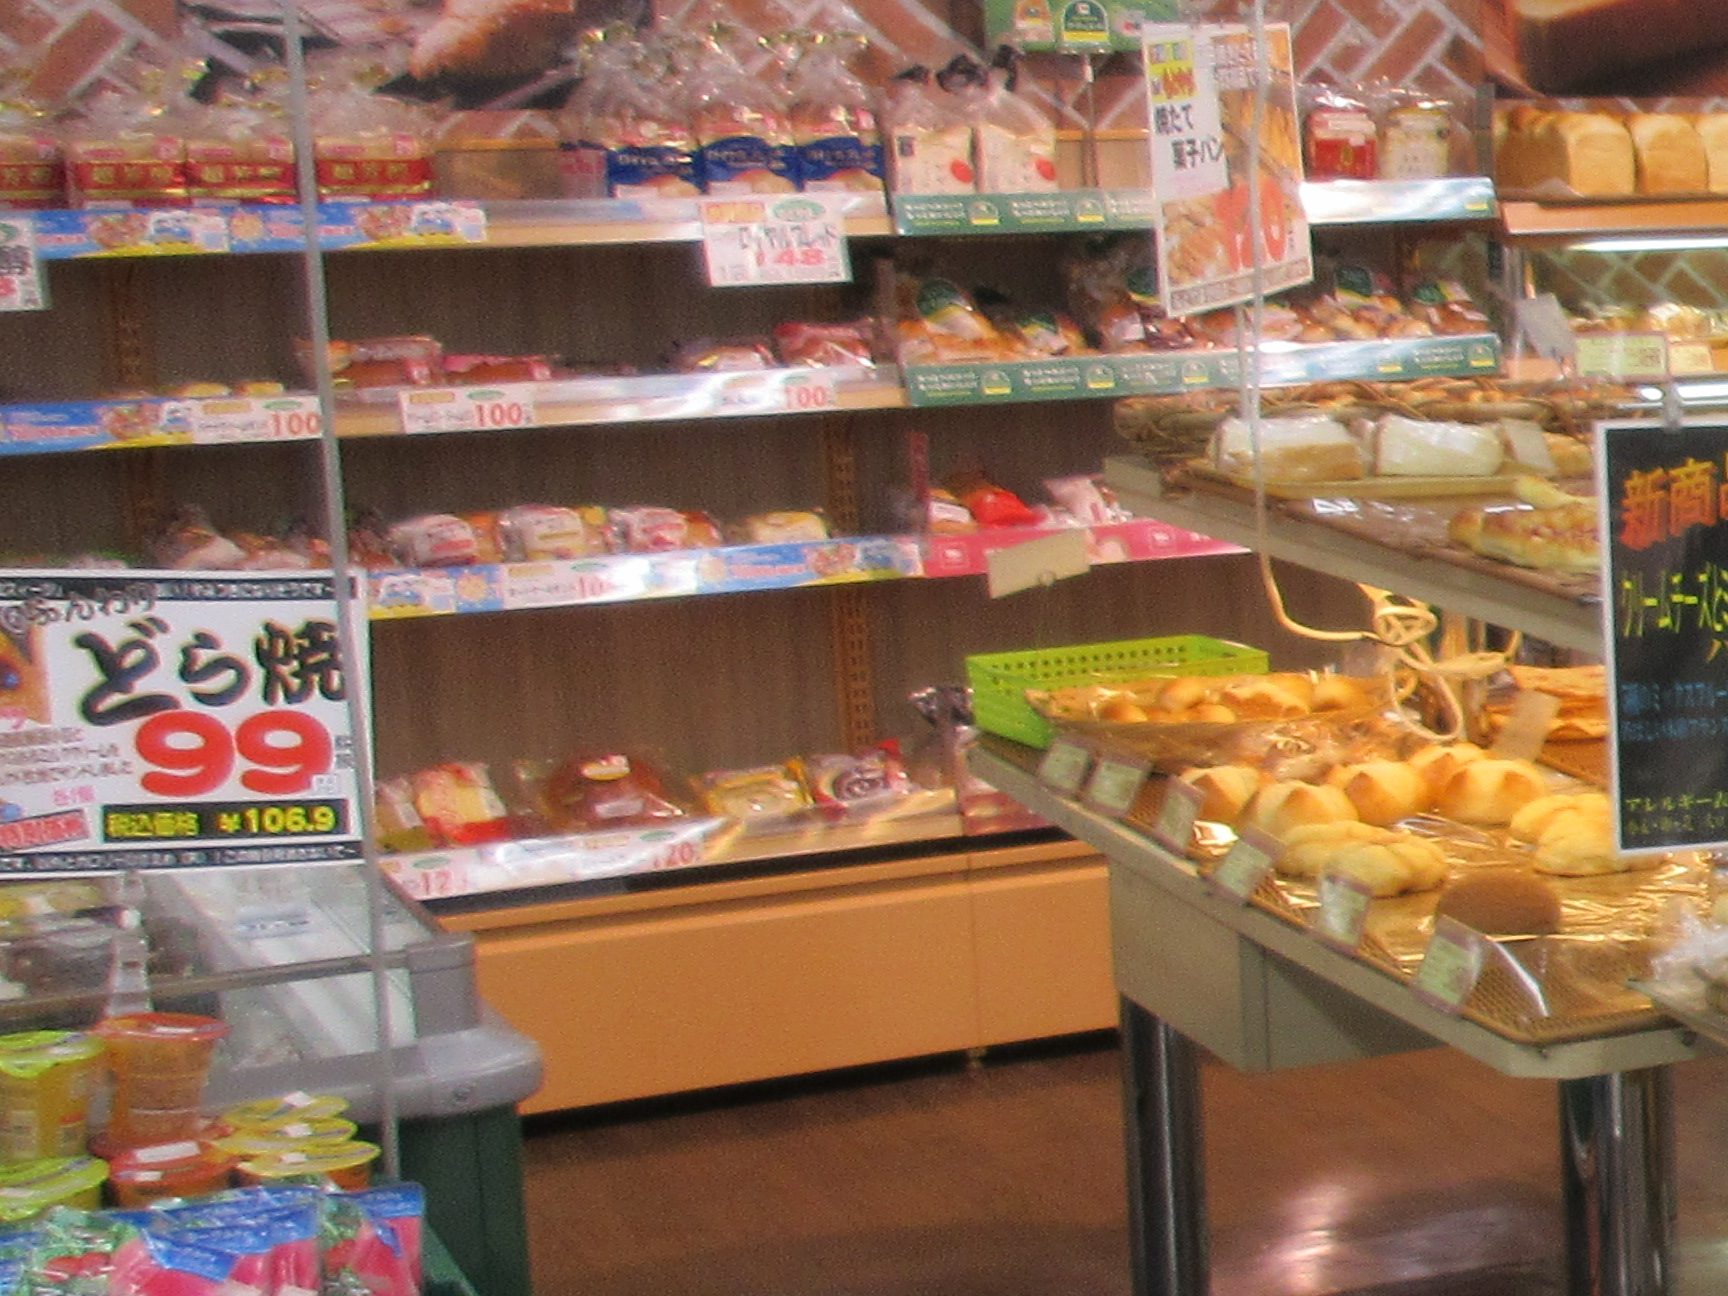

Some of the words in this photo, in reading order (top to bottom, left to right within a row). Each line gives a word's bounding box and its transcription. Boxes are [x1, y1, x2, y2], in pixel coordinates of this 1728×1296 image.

[270, 412, 322, 438] 100
[474, 404, 523, 427] 100
[135, 709, 333, 797] 99
[217, 805, 336, 835] ¥106.9
